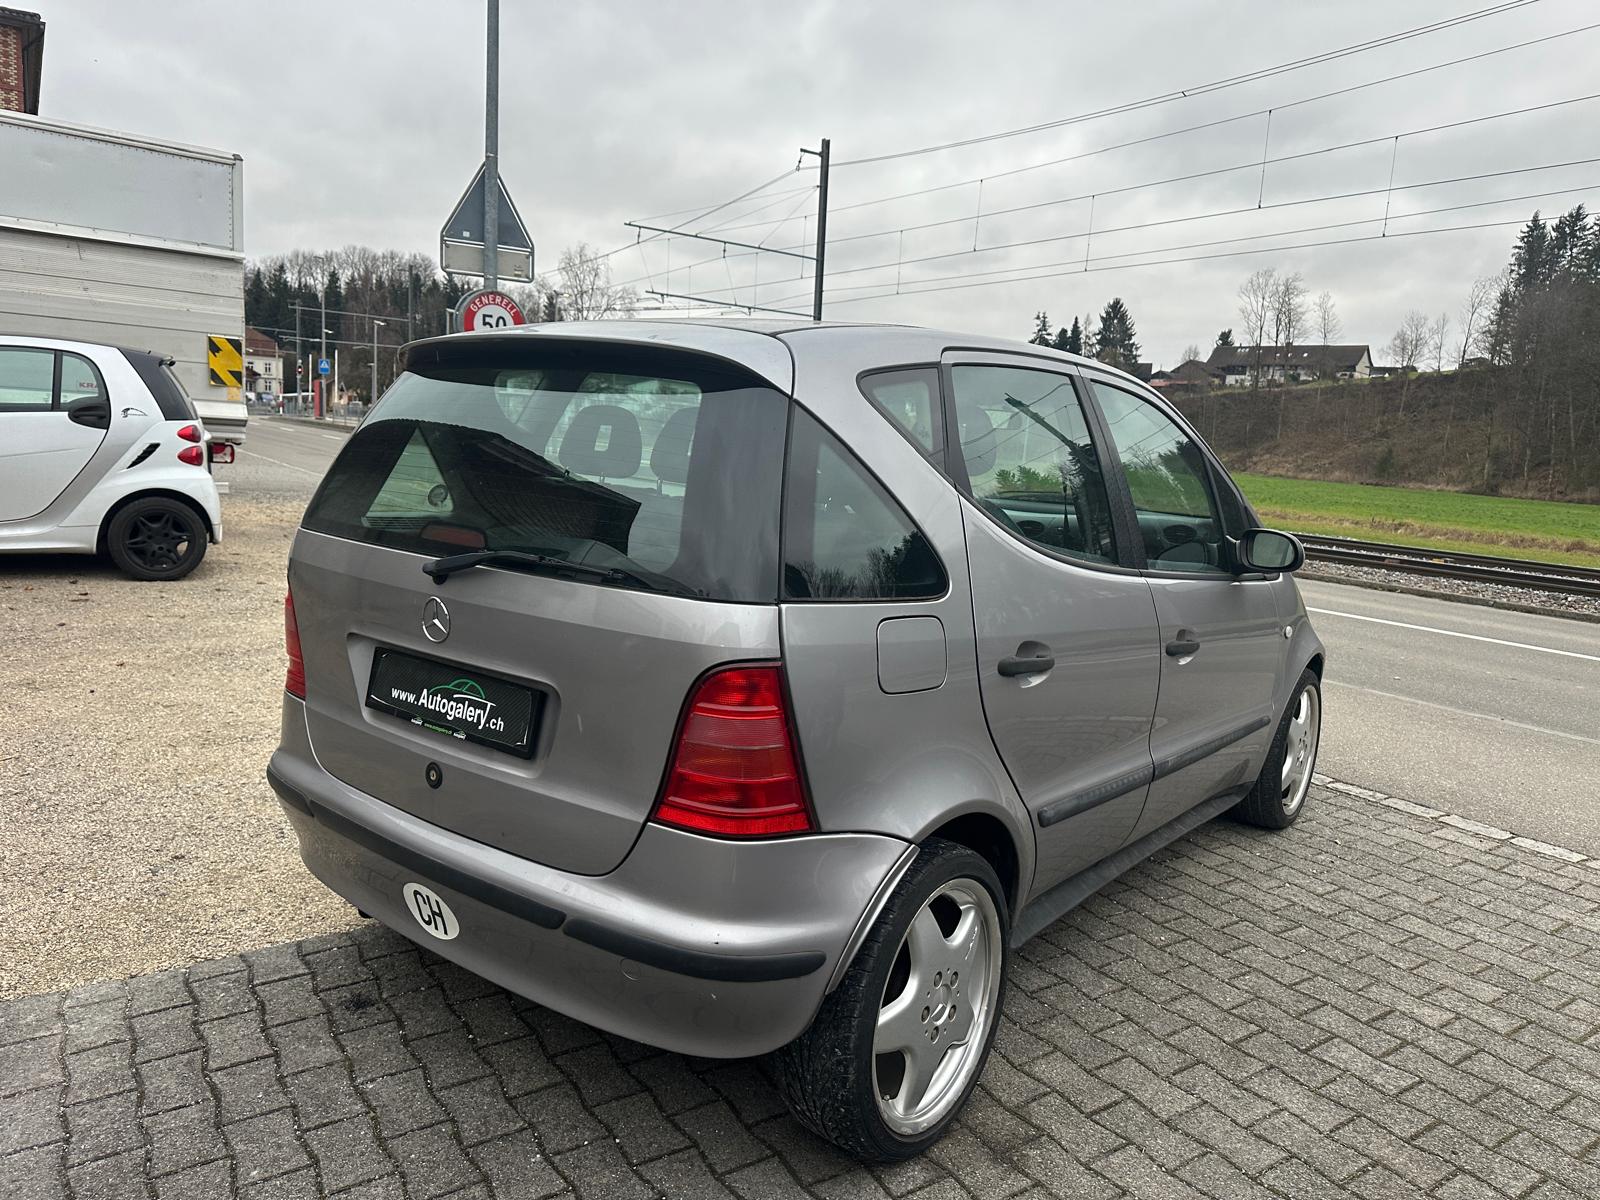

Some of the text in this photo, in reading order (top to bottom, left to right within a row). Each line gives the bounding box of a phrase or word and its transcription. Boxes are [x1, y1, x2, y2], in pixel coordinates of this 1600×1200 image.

[470, 294, 518, 317] GENERELL
[482, 314, 507, 328] 50
[391, 687, 504, 732] www.Autogalery.ch
[413, 889, 448, 936] CH
